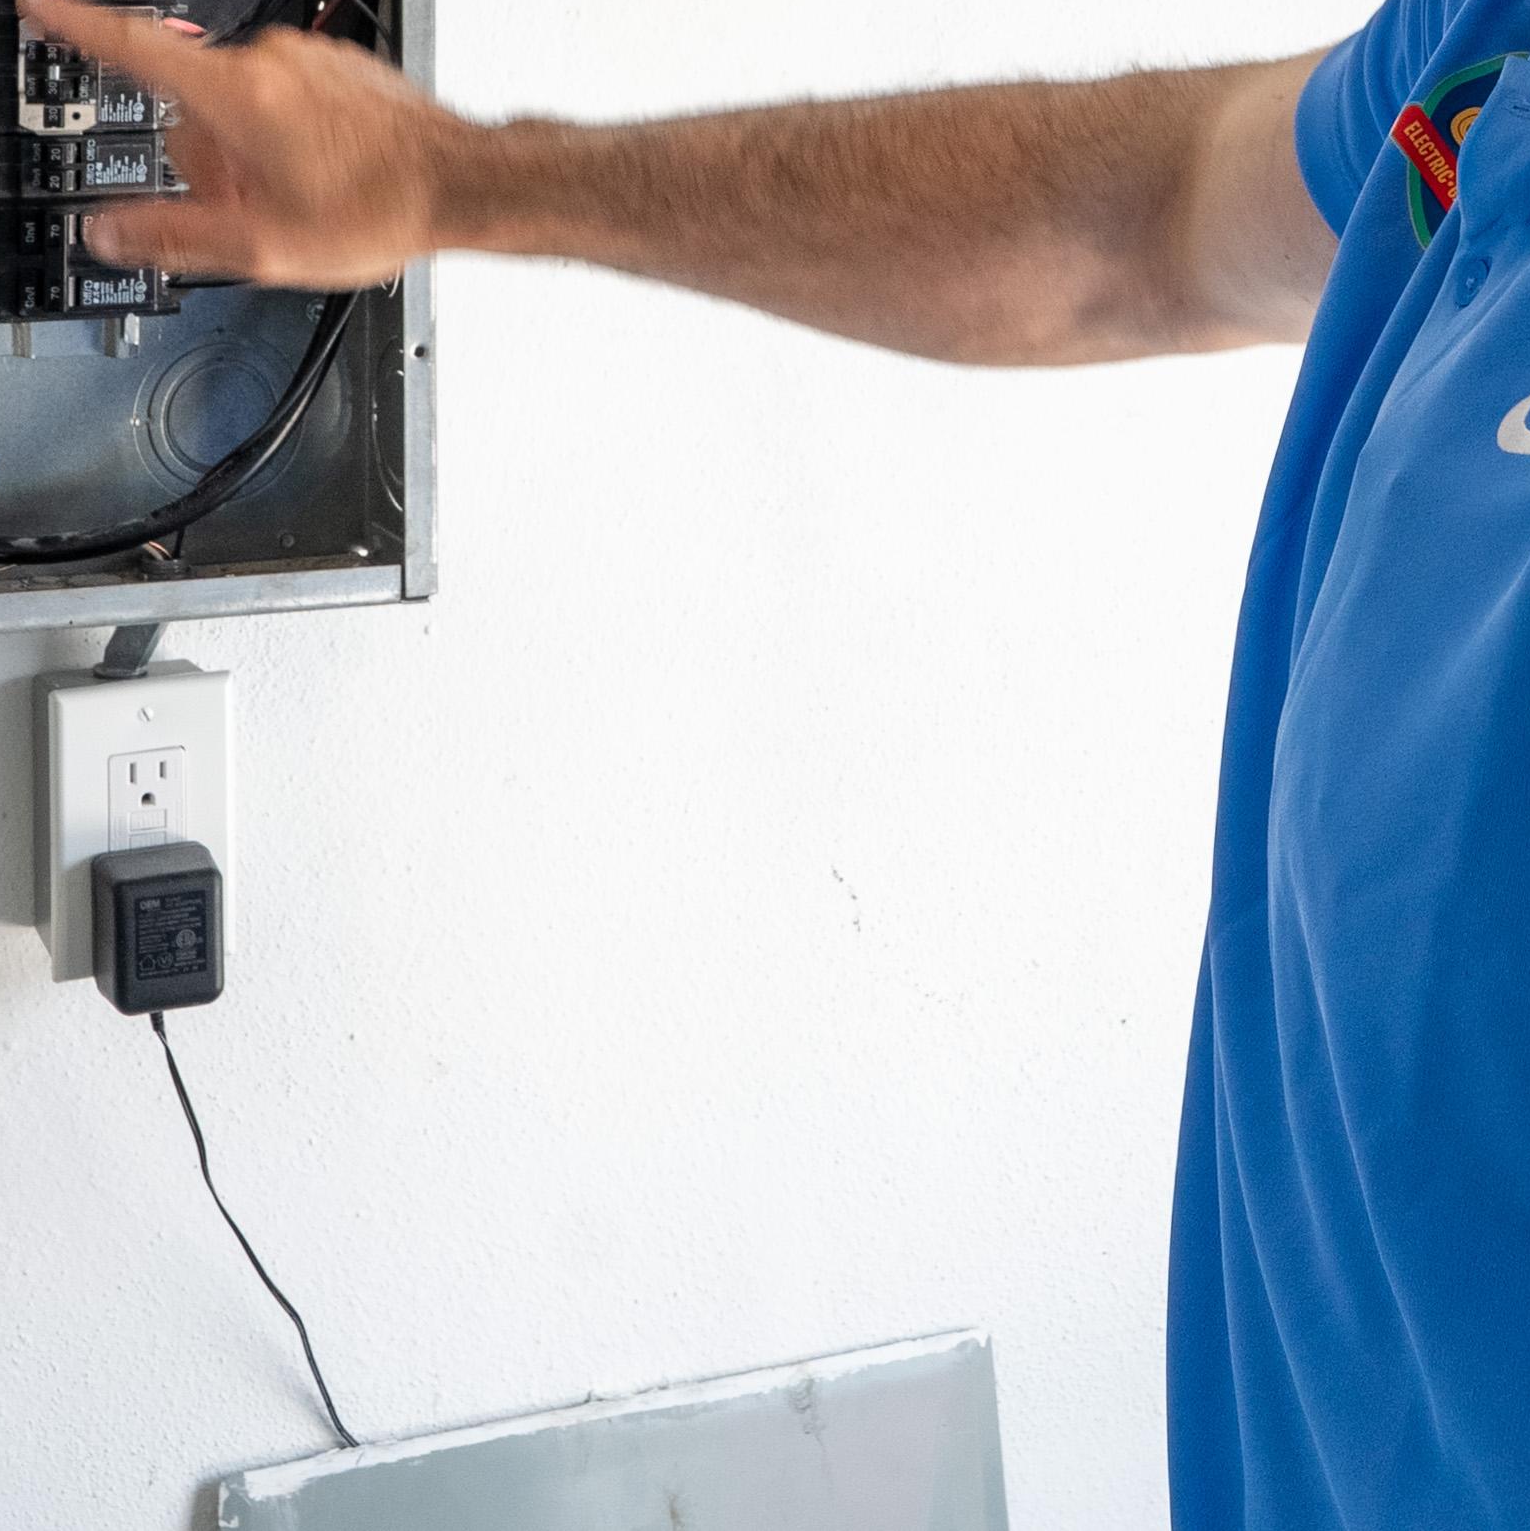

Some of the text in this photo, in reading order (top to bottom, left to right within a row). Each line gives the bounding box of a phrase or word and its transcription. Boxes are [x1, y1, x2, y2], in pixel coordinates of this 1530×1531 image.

[48, 47, 57, 59] 30
[48, 82, 57, 94] 30
[48, 108, 58, 120] 30
[51, 148, 61, 160] 20
[1404, 120, 1455, 183] ELECTRIC
[50, 175, 59, 188] 20
[51, 224, 60, 237] 70
[51, 286, 60, 299] 70
